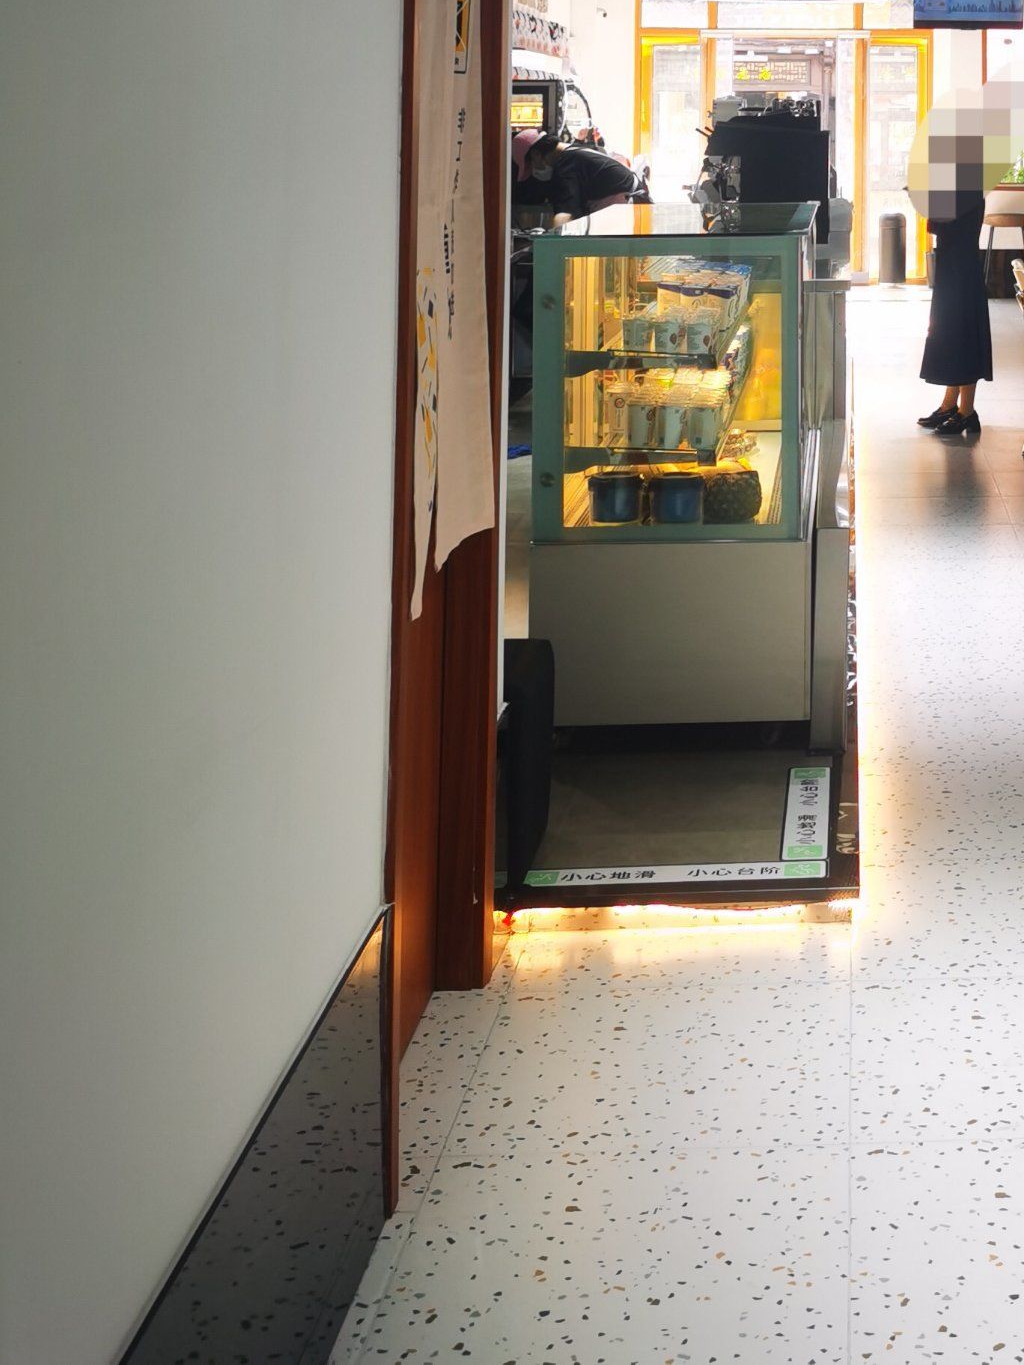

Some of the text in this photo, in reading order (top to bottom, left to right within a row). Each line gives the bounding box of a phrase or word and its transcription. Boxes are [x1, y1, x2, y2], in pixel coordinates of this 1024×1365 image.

[561, 866, 781, 882] 小心地滑 小心台阶
